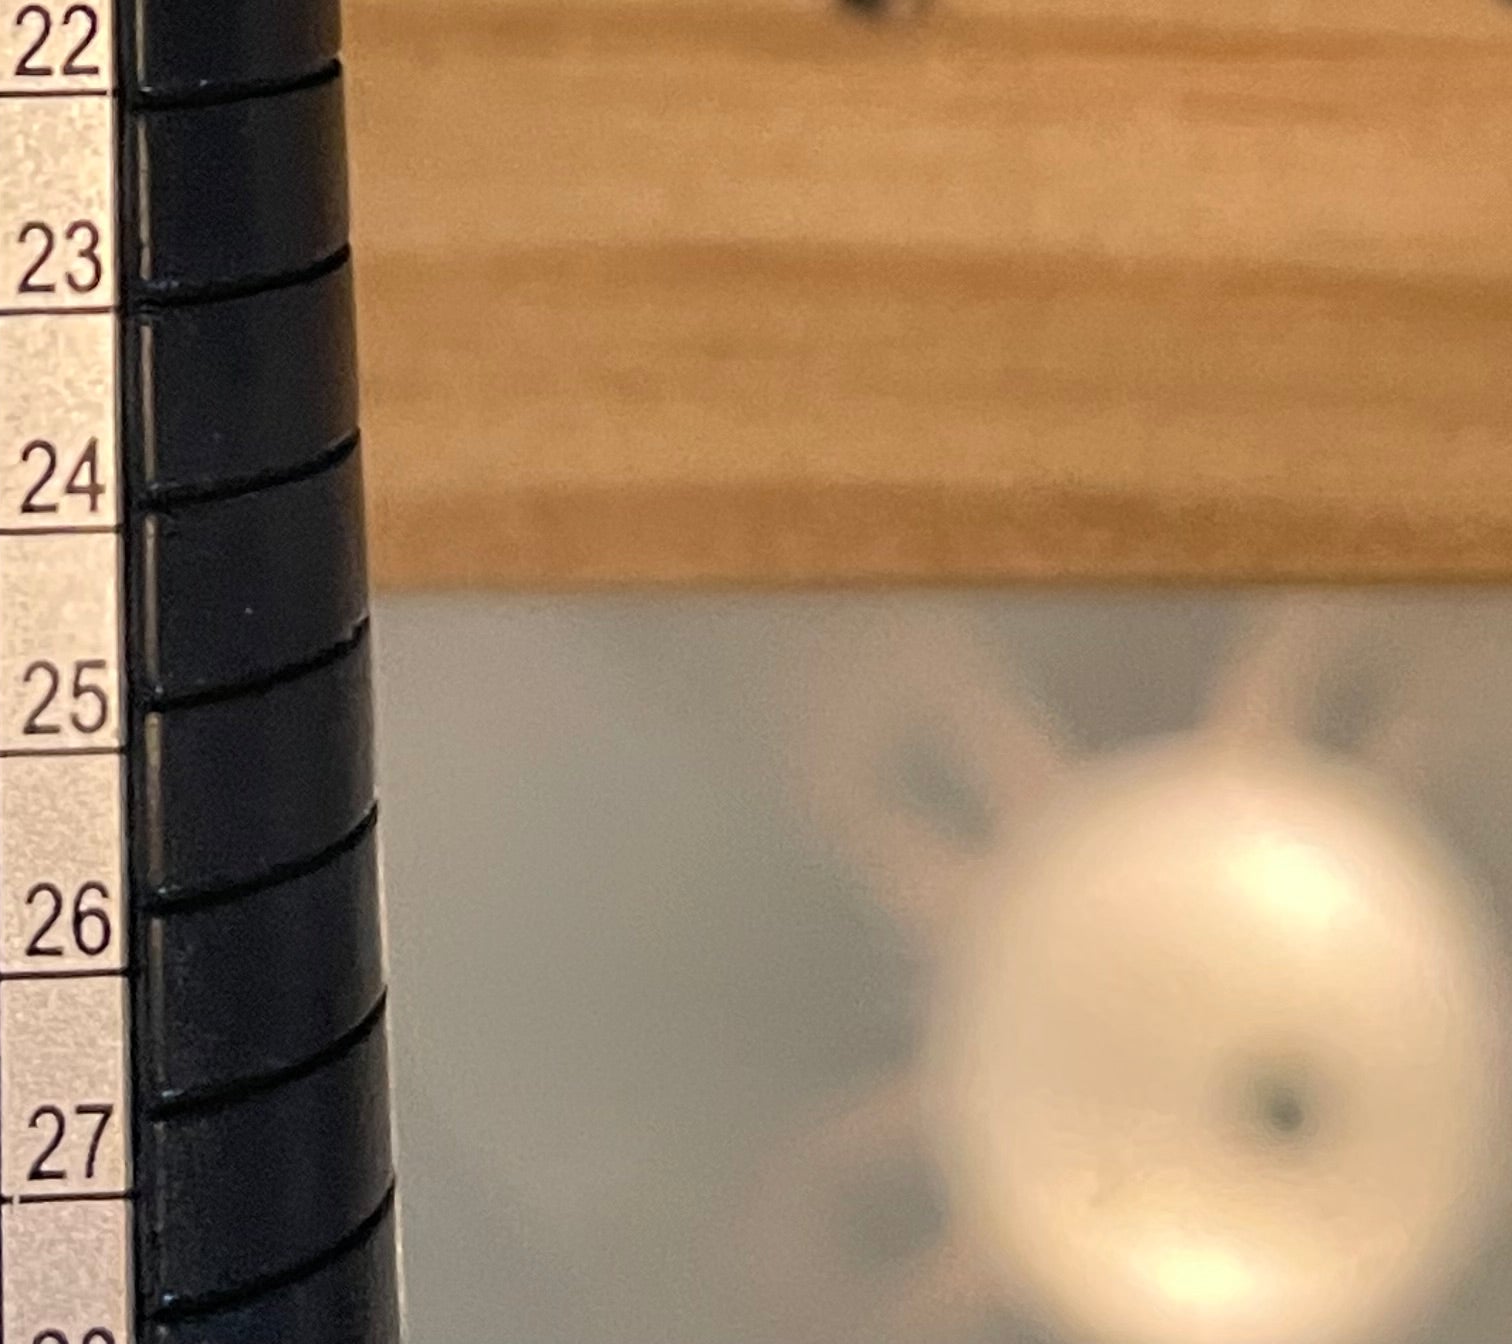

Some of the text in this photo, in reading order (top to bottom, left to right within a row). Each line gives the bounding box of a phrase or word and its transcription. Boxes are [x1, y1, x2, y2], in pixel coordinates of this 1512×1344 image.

[13, 3, 101, 78] 22
[16, 219, 103, 295] 23
[19, 438, 105, 515] 24
[21, 658, 109, 736] 25
[24, 880, 113, 958] 26
[26, 1103, 115, 1183] 27
